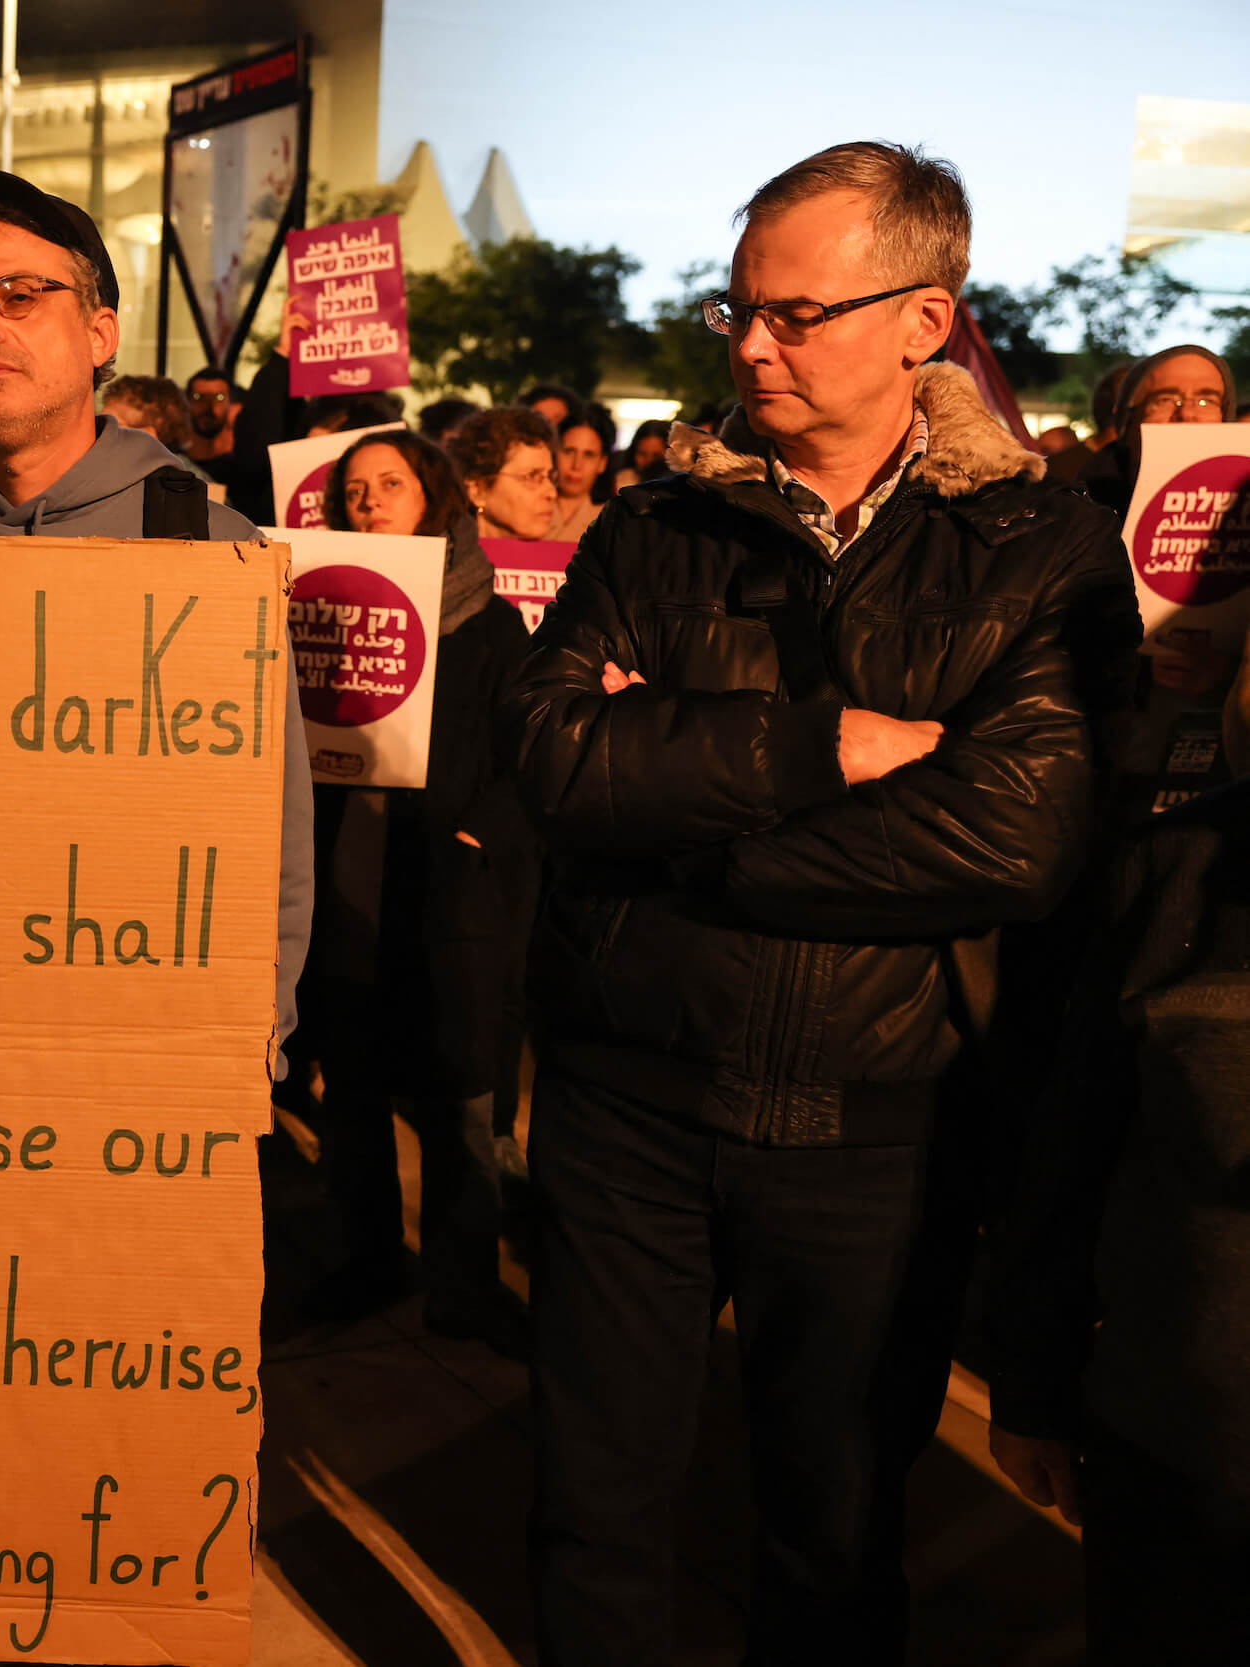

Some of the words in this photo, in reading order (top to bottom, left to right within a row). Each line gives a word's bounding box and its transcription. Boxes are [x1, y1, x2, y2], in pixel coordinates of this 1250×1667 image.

[299, 259, 337, 277] שיש
[343, 249, 390, 270] איפה
[321, 296, 373, 319] מאבק
[306, 340, 364, 360] תקווה
[369, 335, 393, 351] יש
[1162, 486, 1238, 513] שלום
[1155, 511, 1224, 536] السلام
[1150, 537, 1221, 558] ביטחון
[289, 597, 362, 626] שלום
[367, 606, 407, 634] רק
[290, 624, 348, 645] السلا
[353, 633, 406, 655] وحده
[294, 650, 353, 672] ביטח
[358, 655, 406, 675] יביא
[330, 672, 405, 696] سيجلب
[23, 844, 218, 968] shall
[102, 1129, 240, 1178] our
